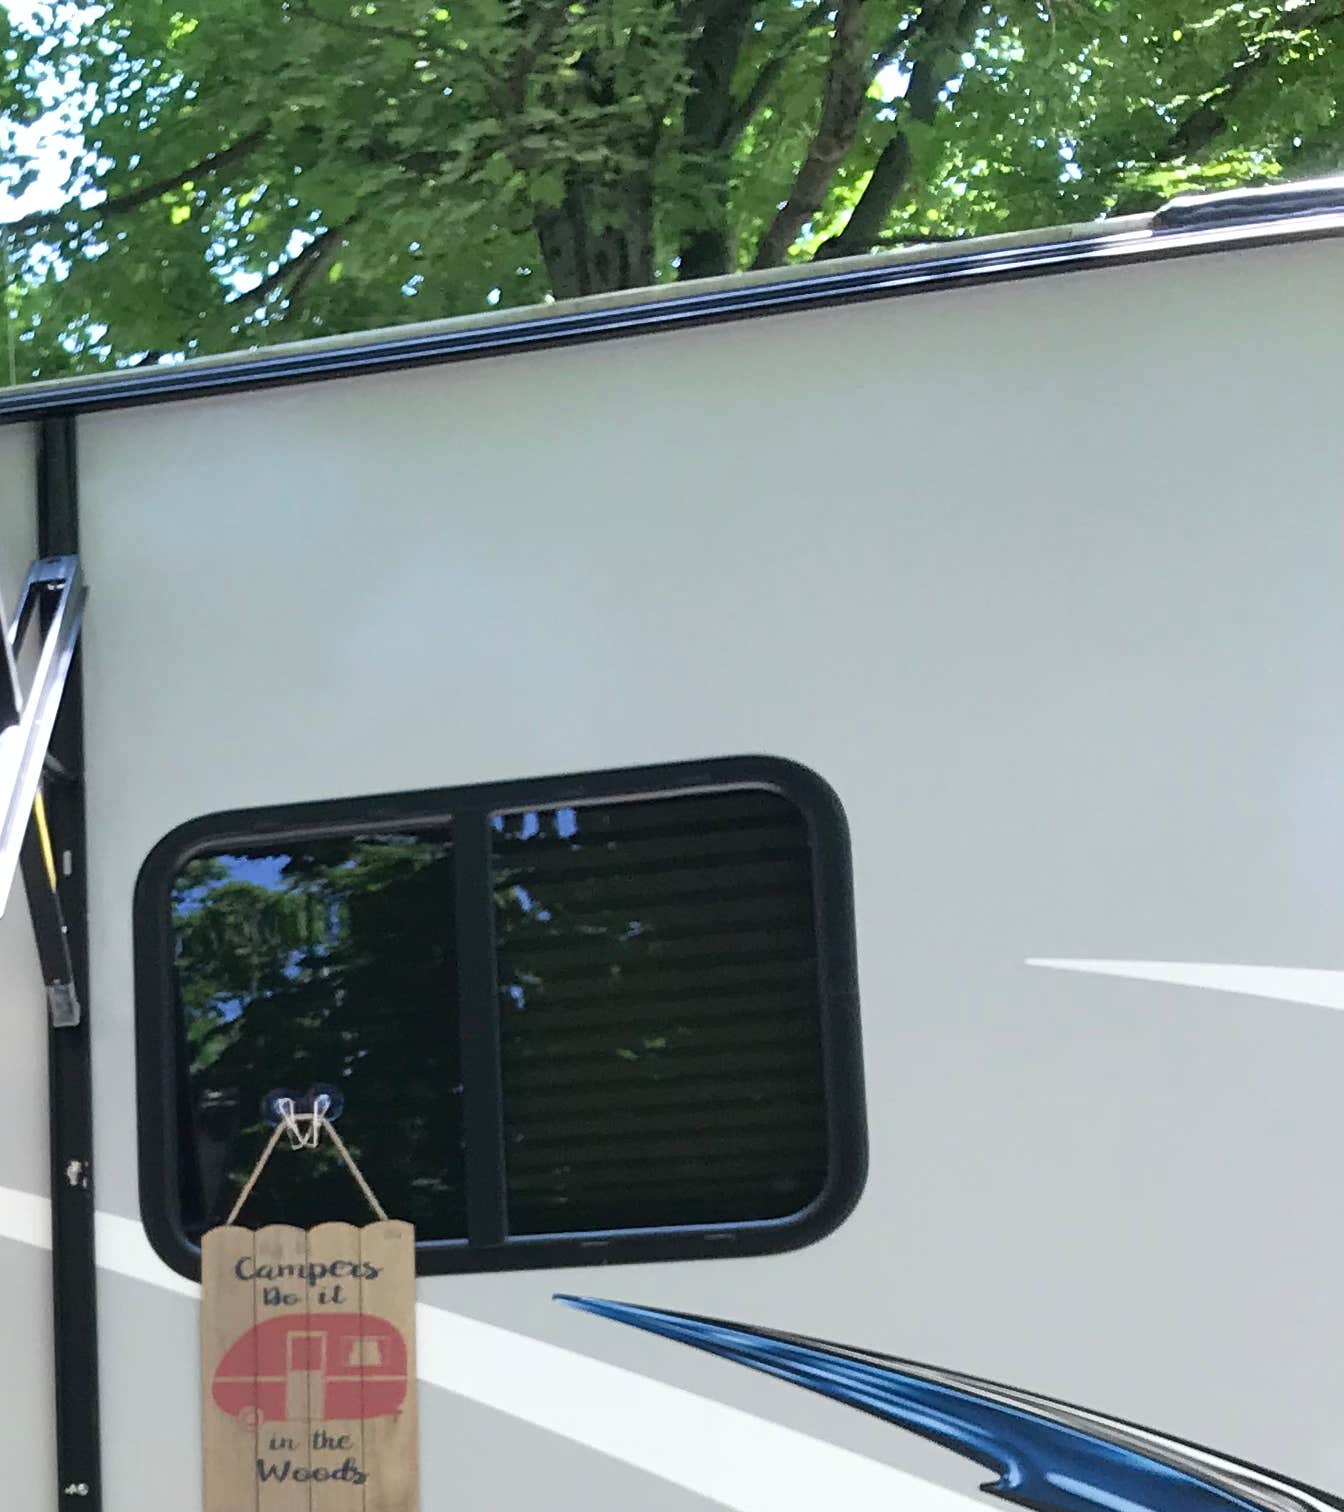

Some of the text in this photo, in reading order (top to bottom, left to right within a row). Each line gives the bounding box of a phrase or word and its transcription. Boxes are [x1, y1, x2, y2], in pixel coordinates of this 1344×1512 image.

[235, 1257, 383, 1287] Campers
[263, 1284, 347, 1306] Do it
[269, 1429, 354, 1451] in the
[255, 1457, 370, 1485] Woods
